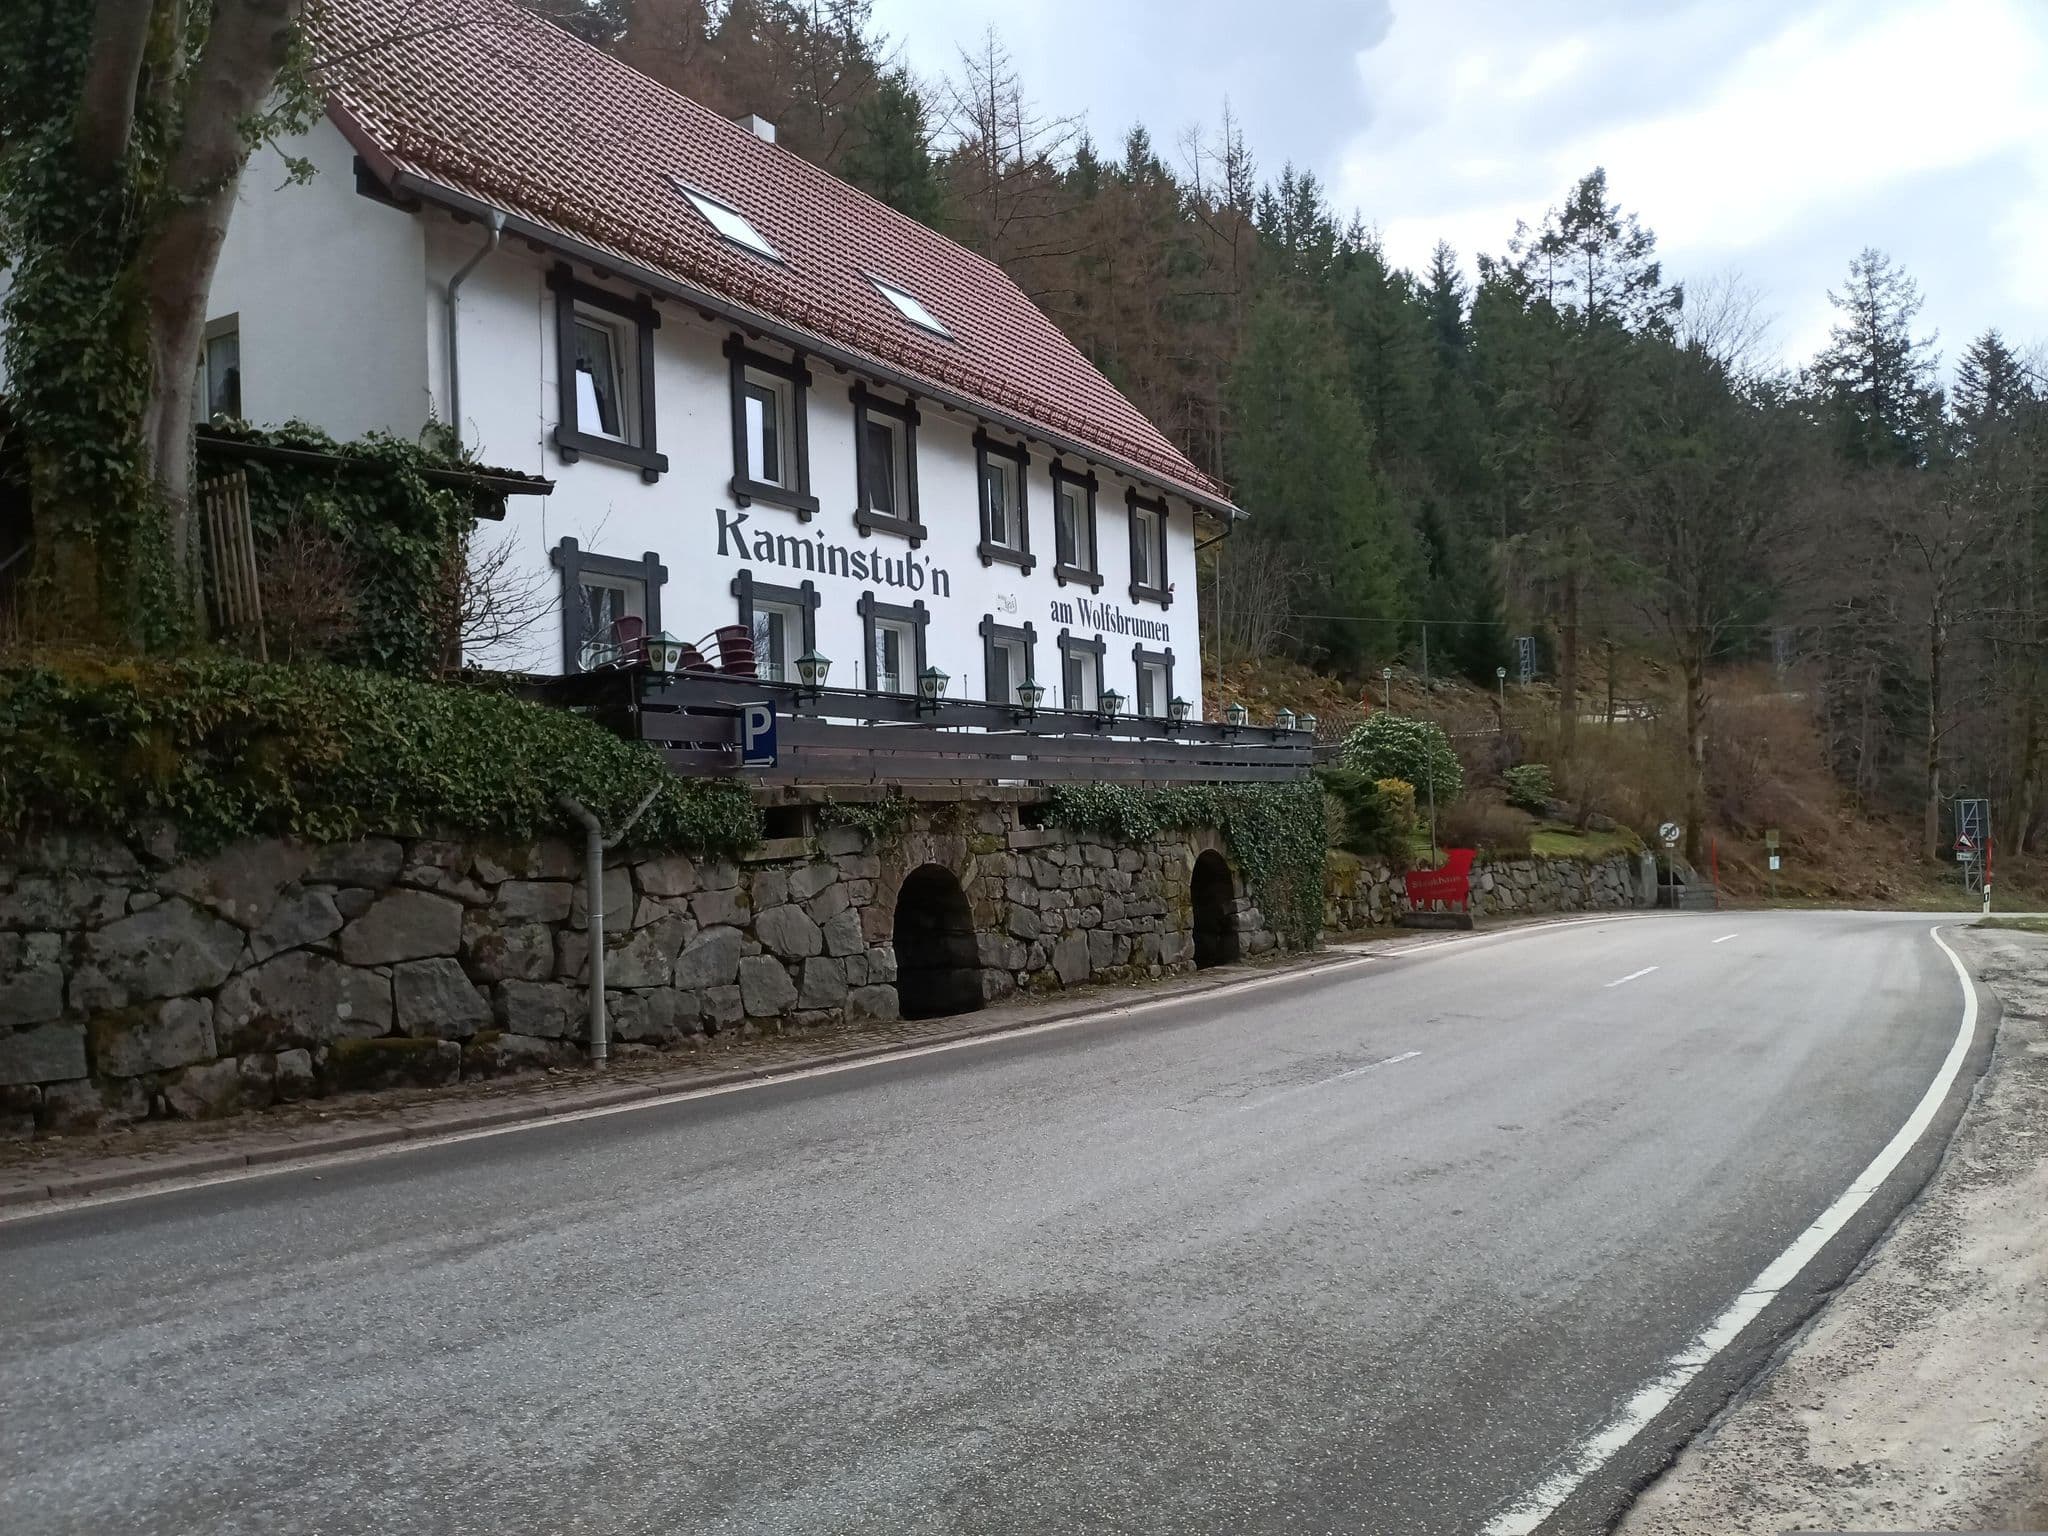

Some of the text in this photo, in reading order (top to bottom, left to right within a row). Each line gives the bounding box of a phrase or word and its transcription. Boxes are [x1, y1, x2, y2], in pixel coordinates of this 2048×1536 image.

[715, 508, 950, 598] Kaminstub'n
[1051, 600, 1074, 625] am
[1076, 597, 1171, 642] Wolfsbrunnen
[744, 706, 772, 751] P
[1662, 826, 1677, 838] 30
